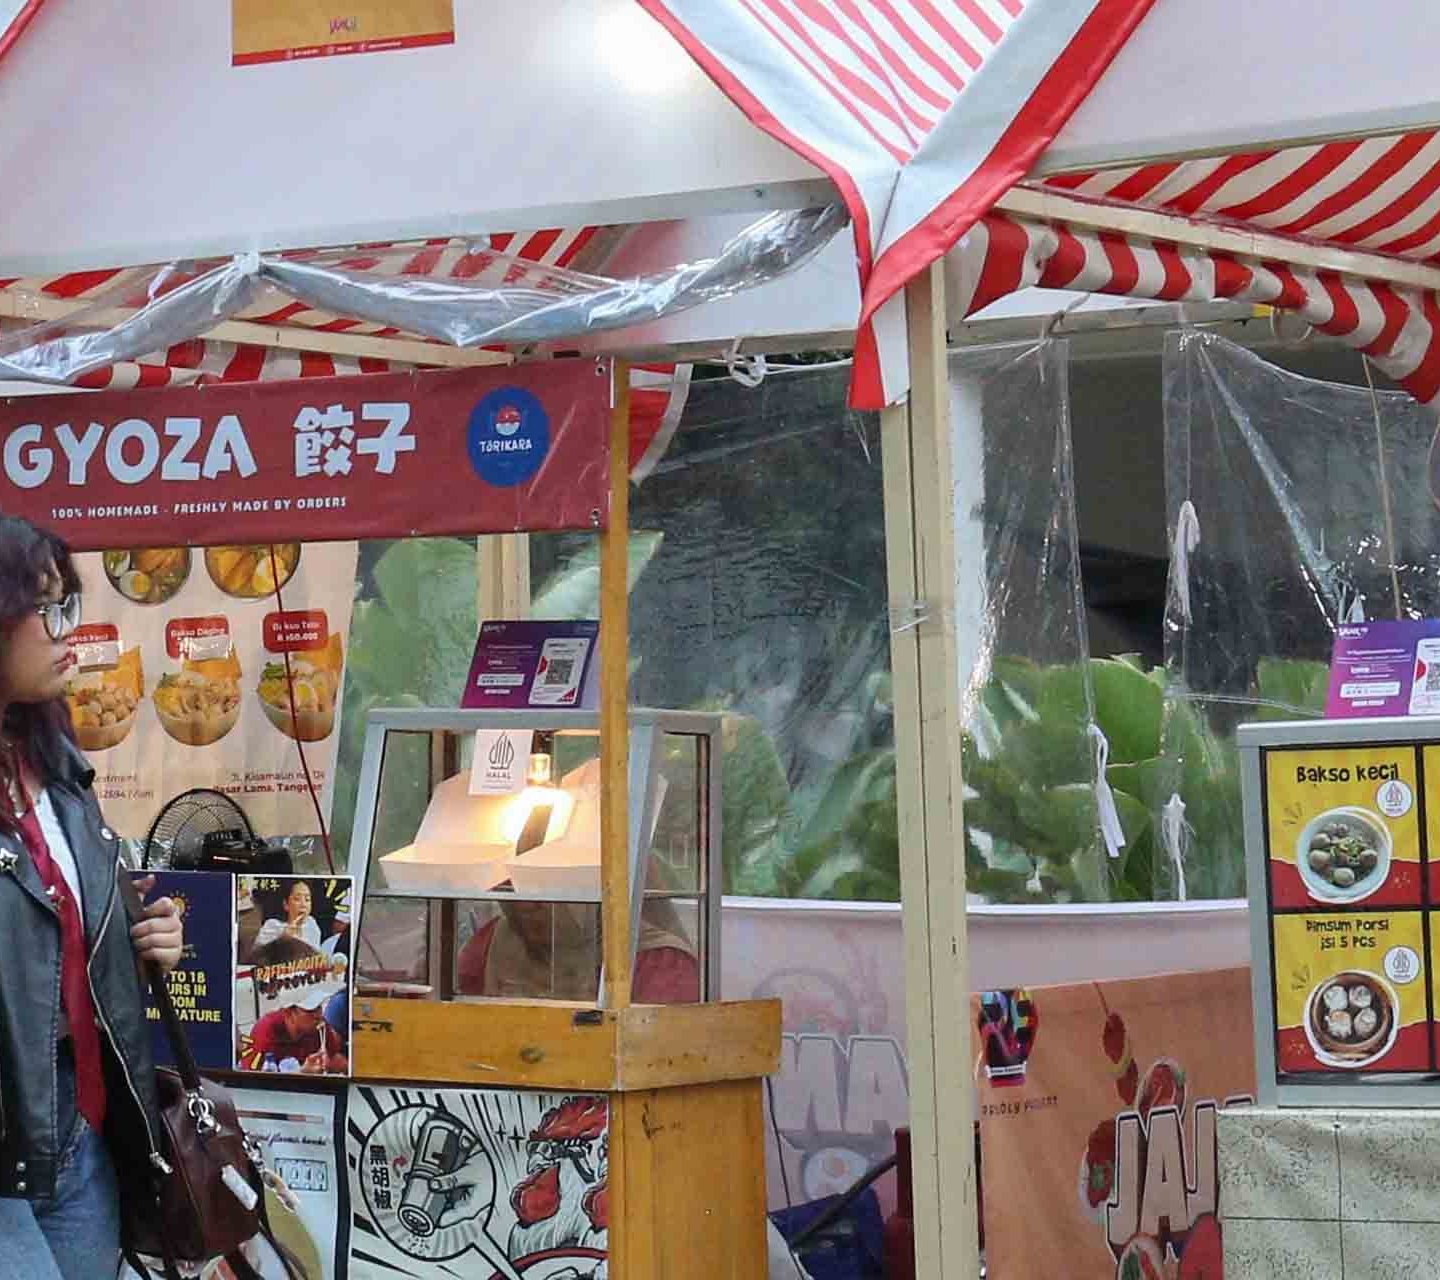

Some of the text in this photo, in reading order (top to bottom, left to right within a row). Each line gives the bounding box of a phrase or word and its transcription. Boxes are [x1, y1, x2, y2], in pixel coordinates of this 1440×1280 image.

[293, 401, 416, 478] 餃子
[2, 414, 258, 489] GYOZA
[51, 506, 83, 519] 100%
[88, 503, 159, 518] HOMEMADE
[174, 500, 228, 516] FRESHLY
[232, 499, 269, 513] MADE
[274, 498, 292, 511] BY
[297, 496, 347, 510] ORDERS
[1296, 763, 1399, 784] Bakso kecil
[1306, 918, 1390, 933] Dimsum Porsi
[1340, 936, 1349, 949] 5
[171, 970, 206, 984] TO 18
[194, 984, 207, 997] IN
